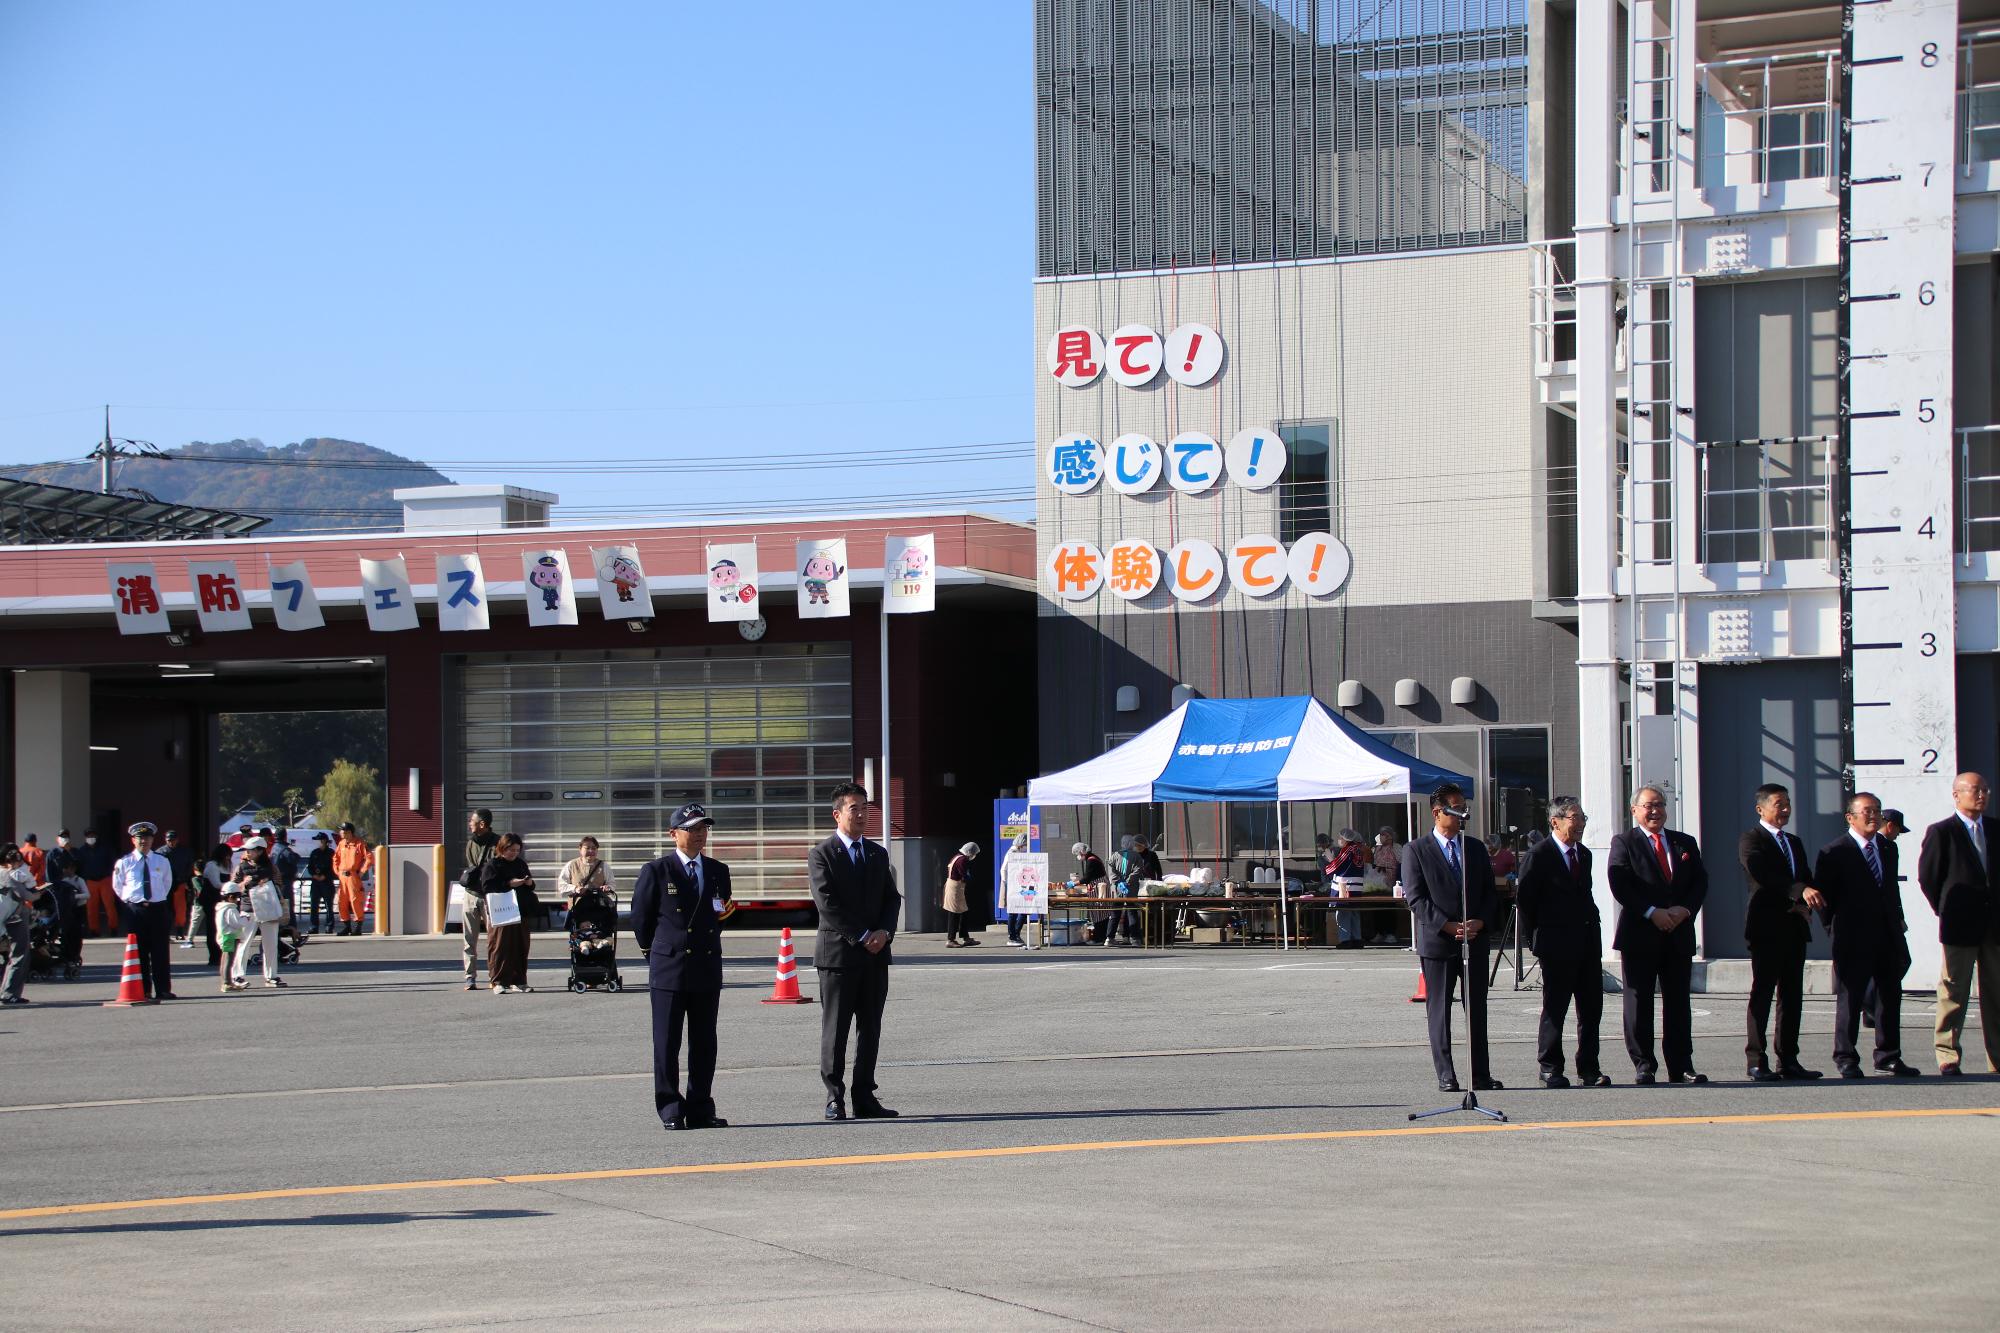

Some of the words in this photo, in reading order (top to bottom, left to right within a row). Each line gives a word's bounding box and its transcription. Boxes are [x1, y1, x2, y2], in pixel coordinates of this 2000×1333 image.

[1921, 42, 1939, 68] 8
[1920, 162, 1937, 187] 7
[1918, 281, 1936, 306] 6
[1918, 398, 1935, 423] 5
[1918, 516, 1936, 540] 4
[903, 584, 922, 595] 119
[1920, 632, 1937, 657] 3
[1178, 736, 1293, 756] 赤磐市消防団
[1921, 748, 1939, 774] 2
